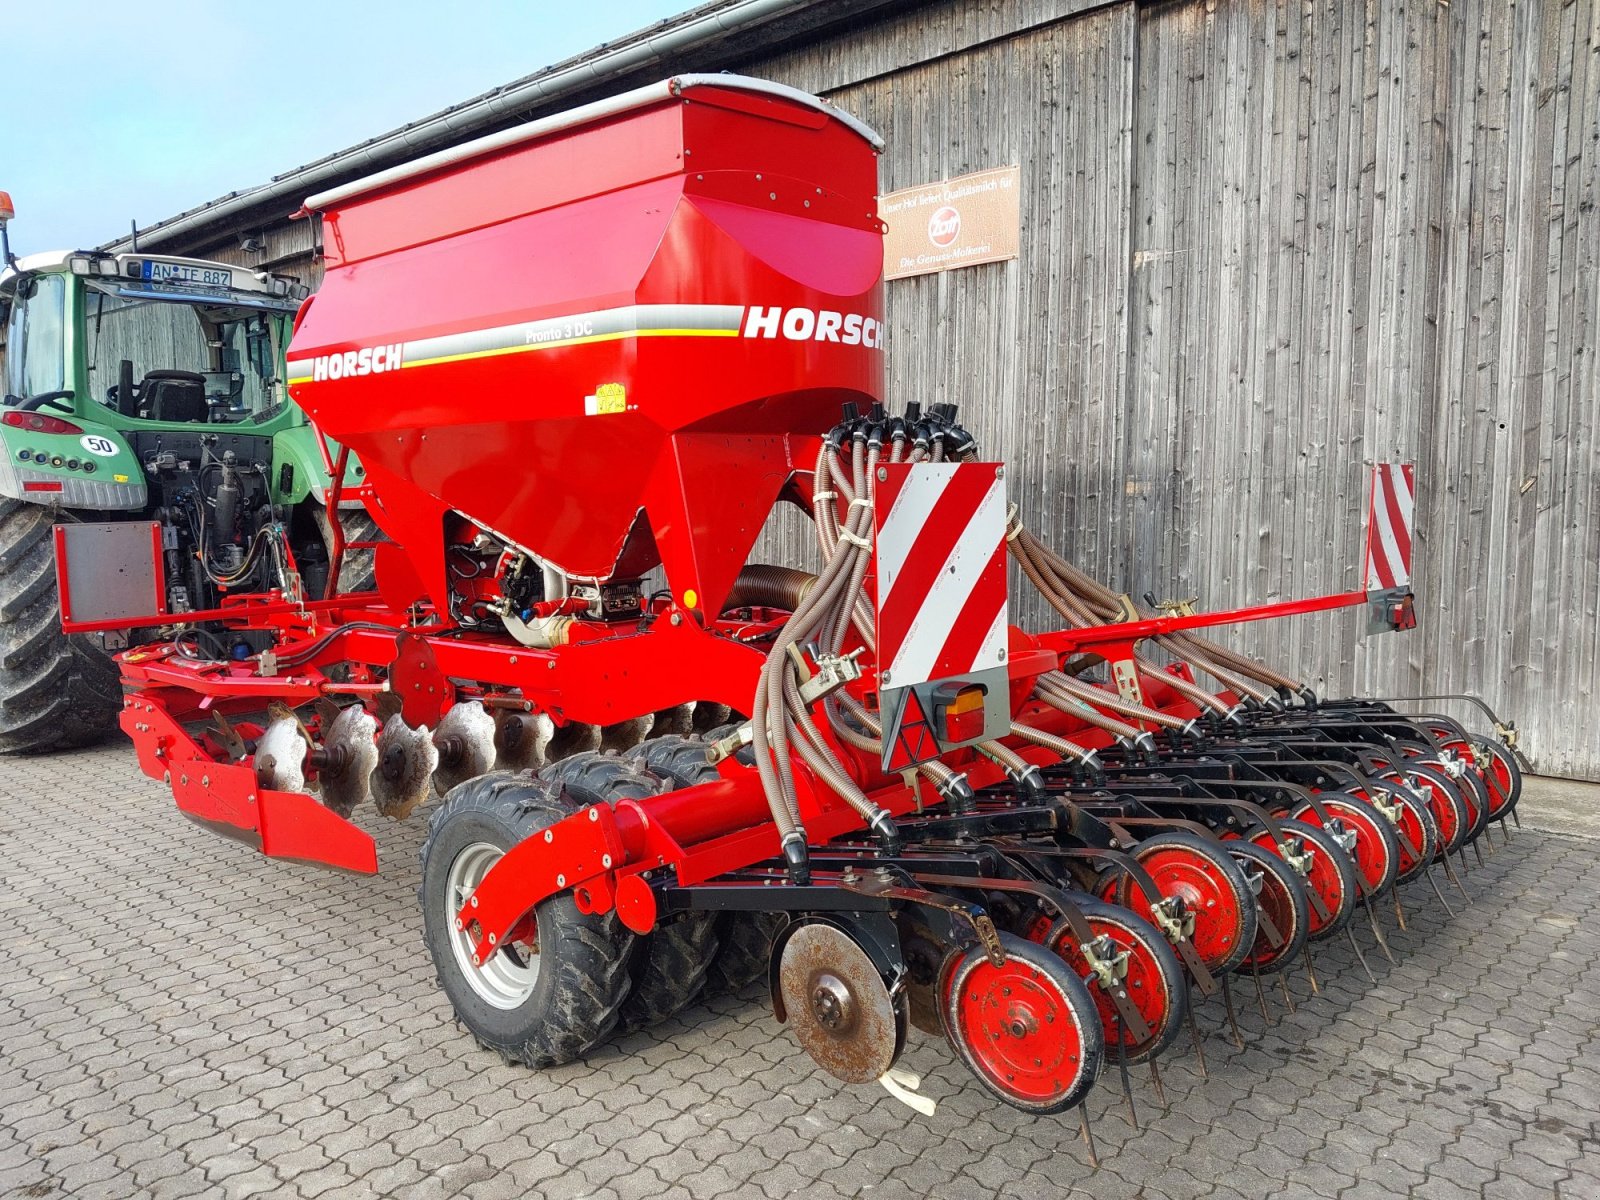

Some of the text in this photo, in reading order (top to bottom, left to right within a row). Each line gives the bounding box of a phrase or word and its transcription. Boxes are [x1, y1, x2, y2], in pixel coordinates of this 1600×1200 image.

[903, 195, 917, 209] Hof
[919, 193, 941, 205] liefert
[943, 179, 997, 201] Qualitätsmilch
[1000, 176, 1012, 189] für
[900, 243, 991, 267] Die Genuss-Molkerei
[153, 264, 171, 279] AN
[203, 270, 229, 286] 887
[526, 319, 593, 344] Pronto 3 DC
[743, 305, 884, 350] HORSCH
[313, 343, 402, 382] HORSCH
[87, 437, 113, 453] 50
